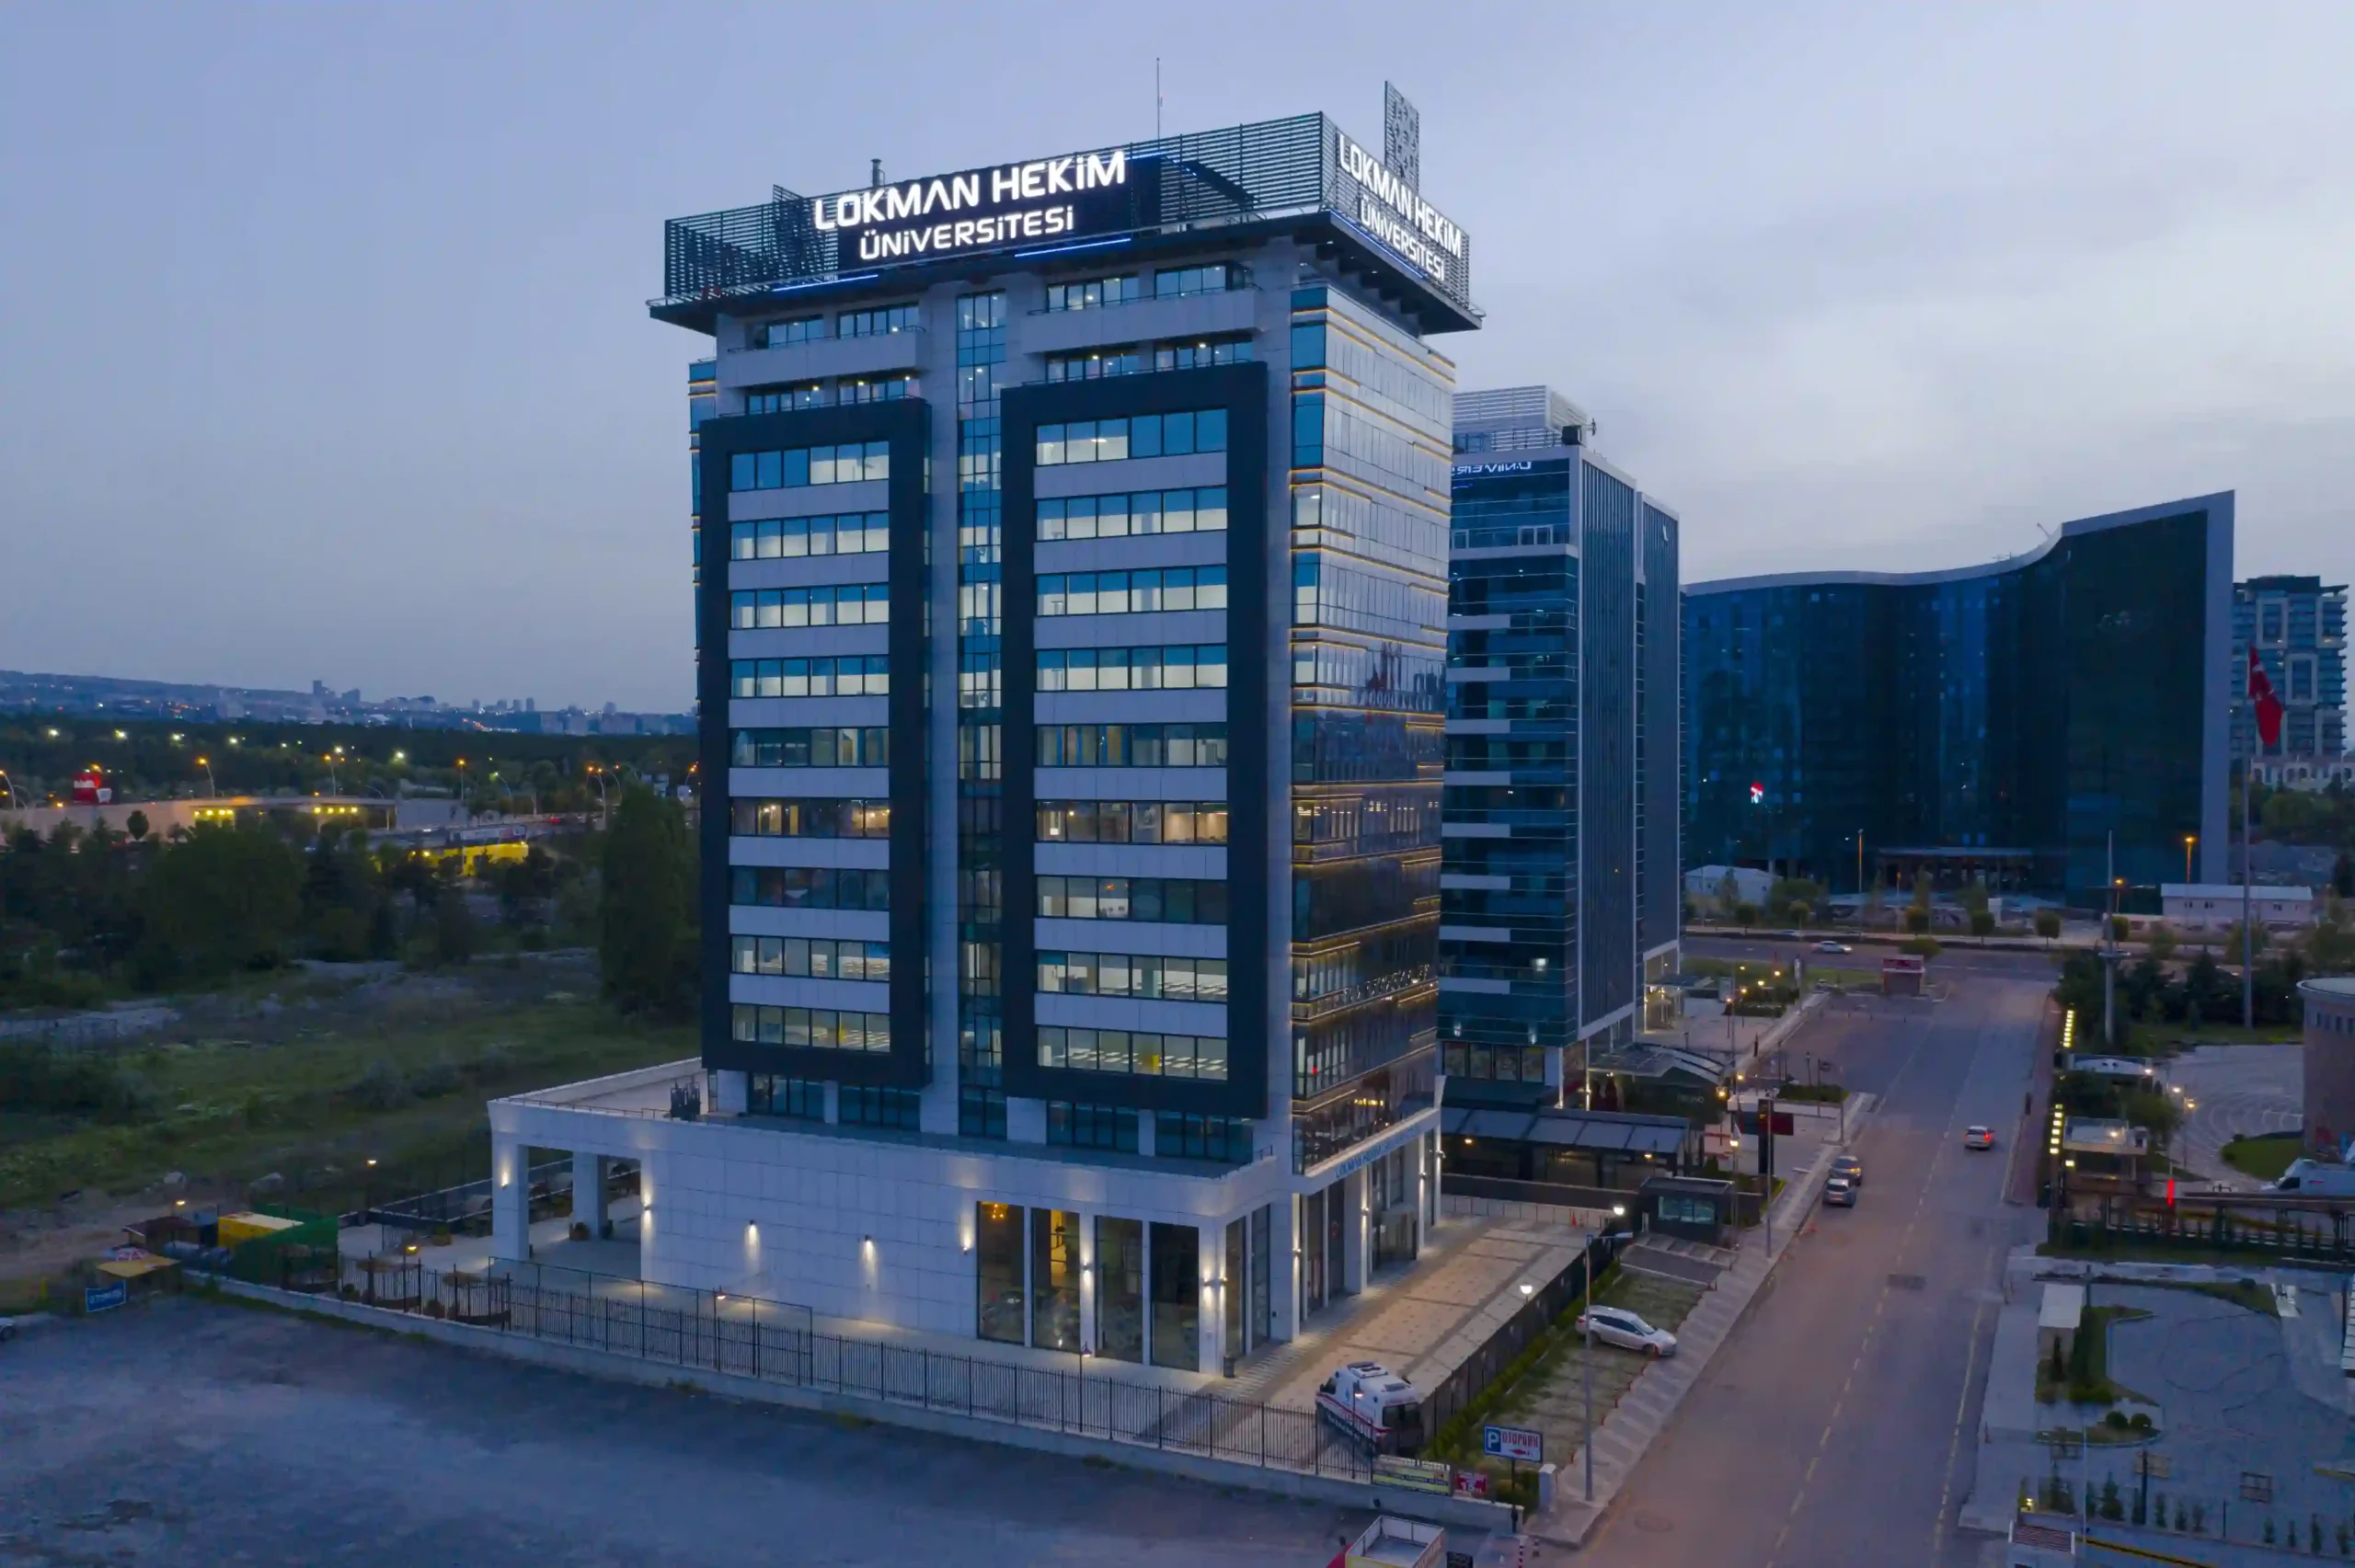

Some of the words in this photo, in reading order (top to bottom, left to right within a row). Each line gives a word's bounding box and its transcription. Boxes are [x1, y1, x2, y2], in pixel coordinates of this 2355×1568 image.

[815, 174, 979, 230] LOKMAN
[993, 151, 1125, 202] HEKİM
[1339, 133, 1413, 219] LOKMAN
[1415, 196, 1462, 258] HEKİM
[860, 206, 1074, 259] ÜNİVERSİTESİ
